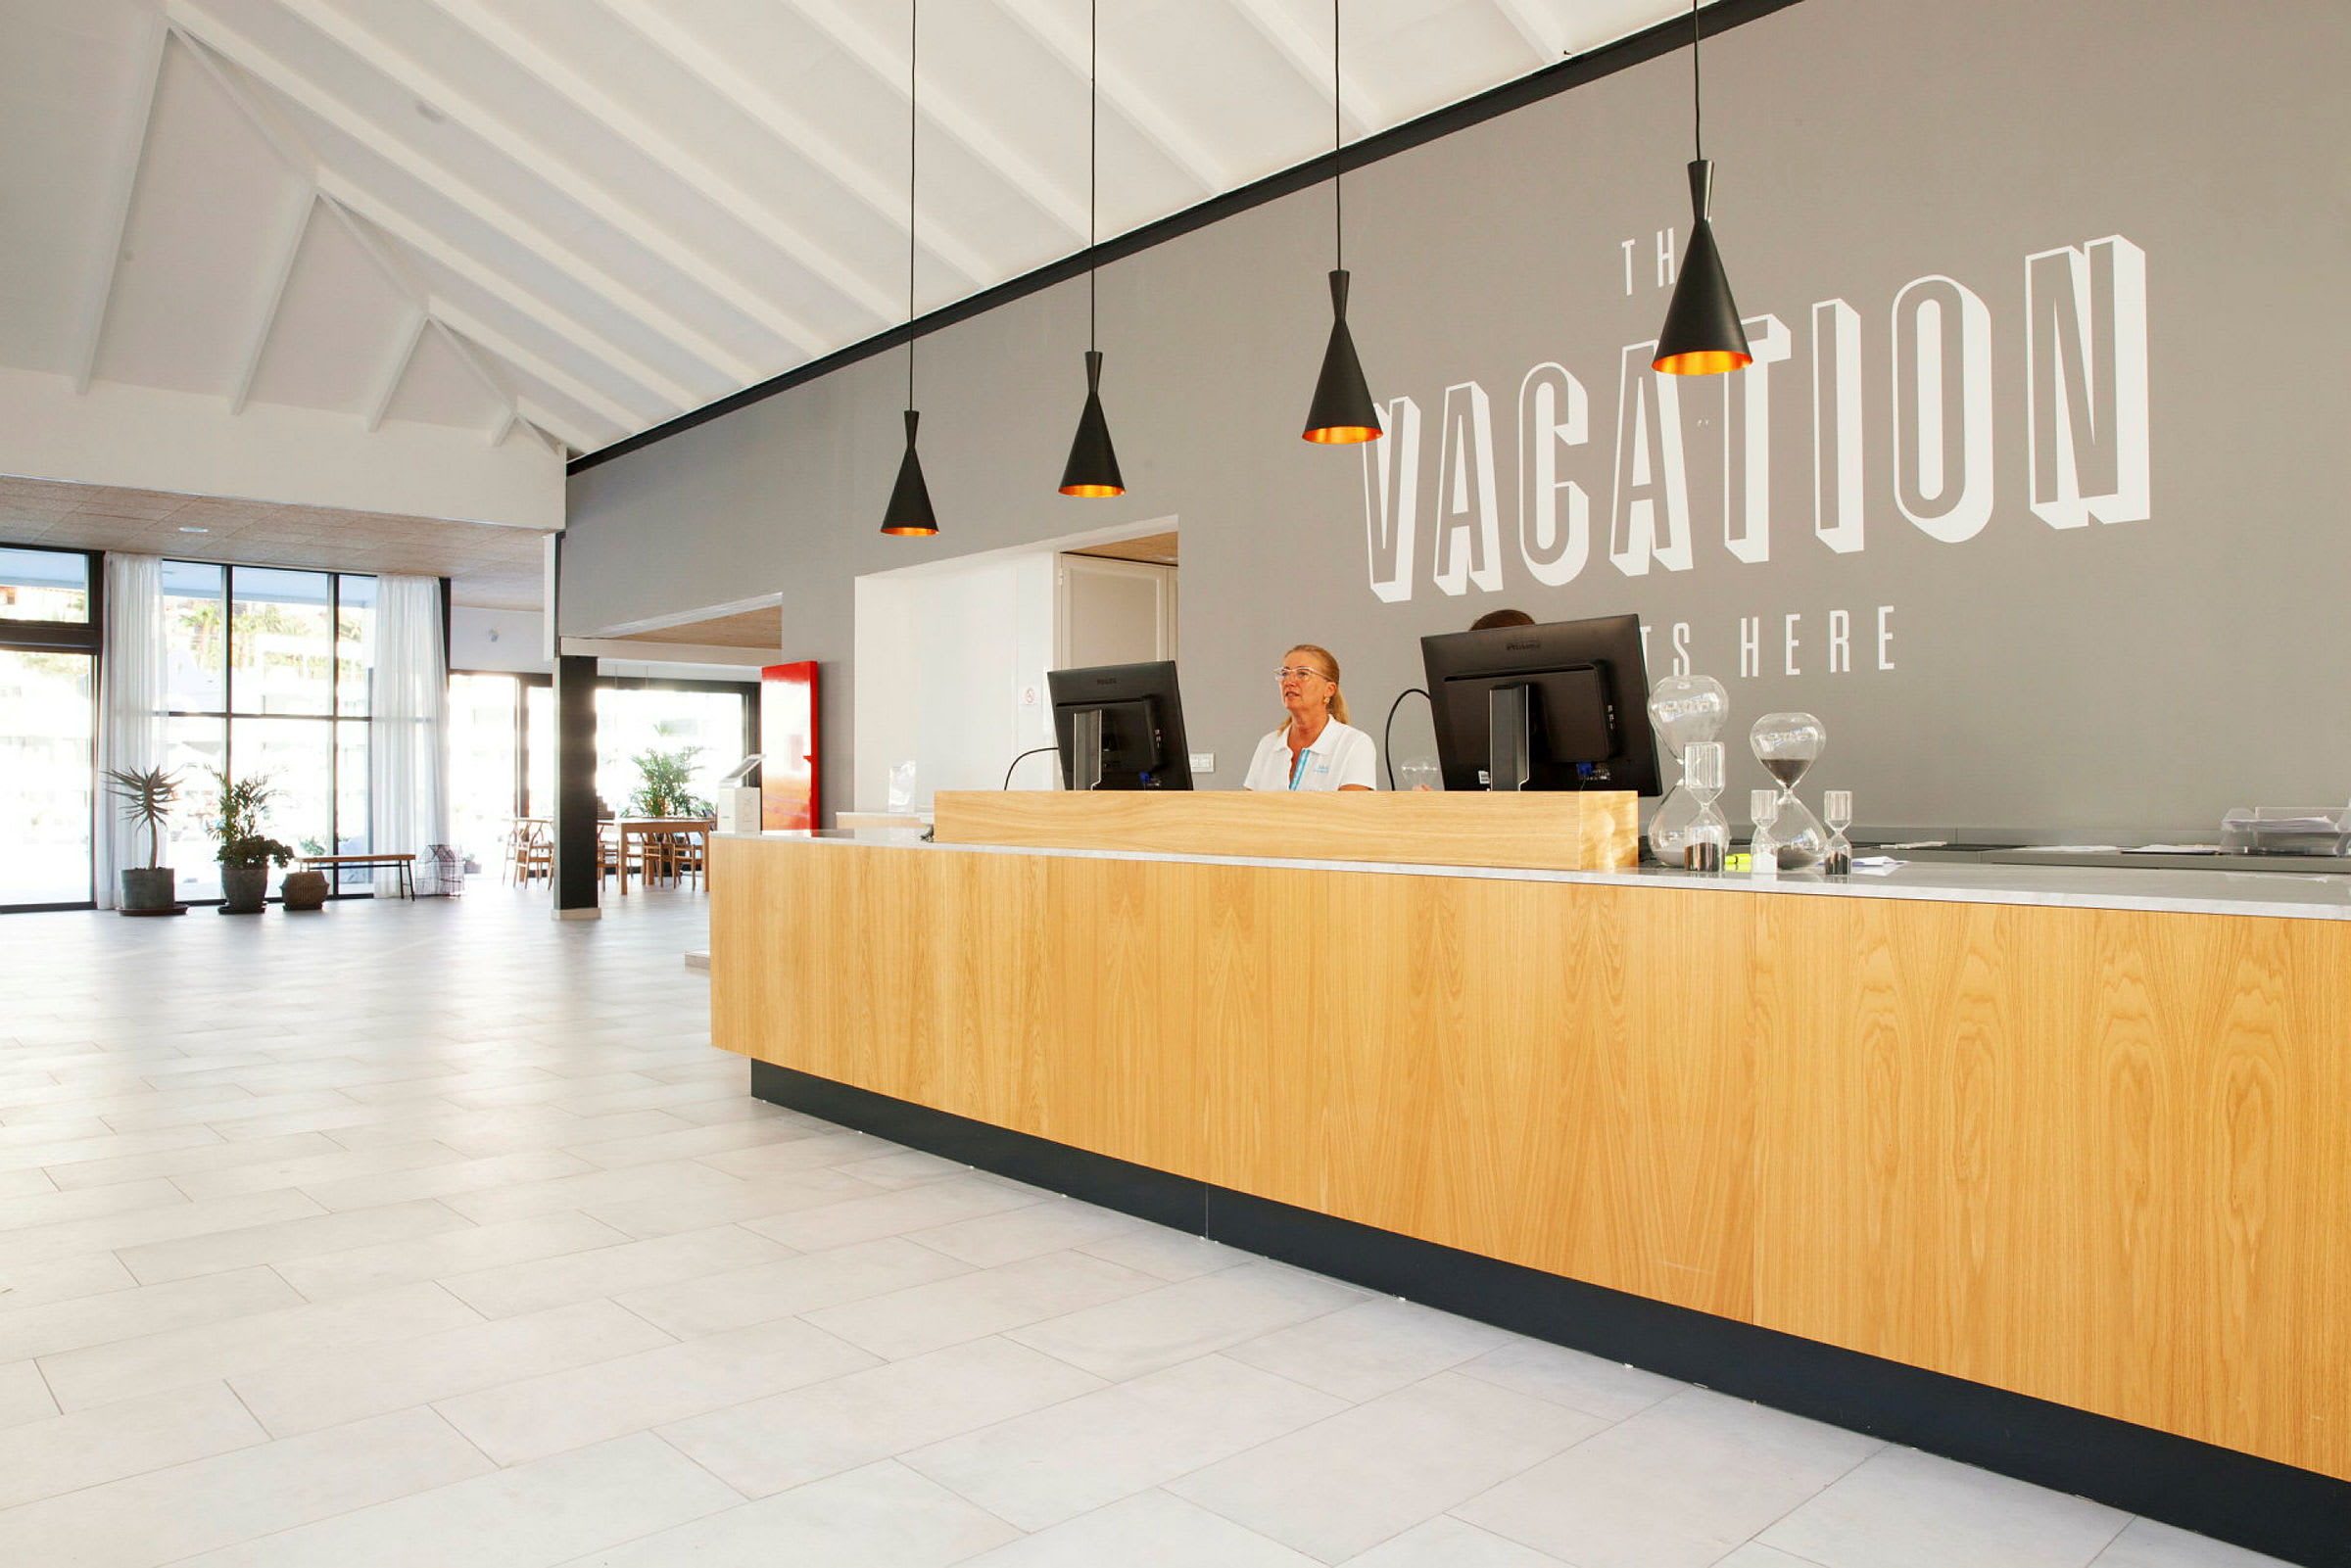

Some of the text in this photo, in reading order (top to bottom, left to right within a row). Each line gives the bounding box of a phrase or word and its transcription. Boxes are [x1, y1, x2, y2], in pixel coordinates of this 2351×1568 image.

[1621, 219, 1703, 296] TH
[1363, 235, 2150, 603] VACATION
[1740, 605, 1895, 678] HERE
